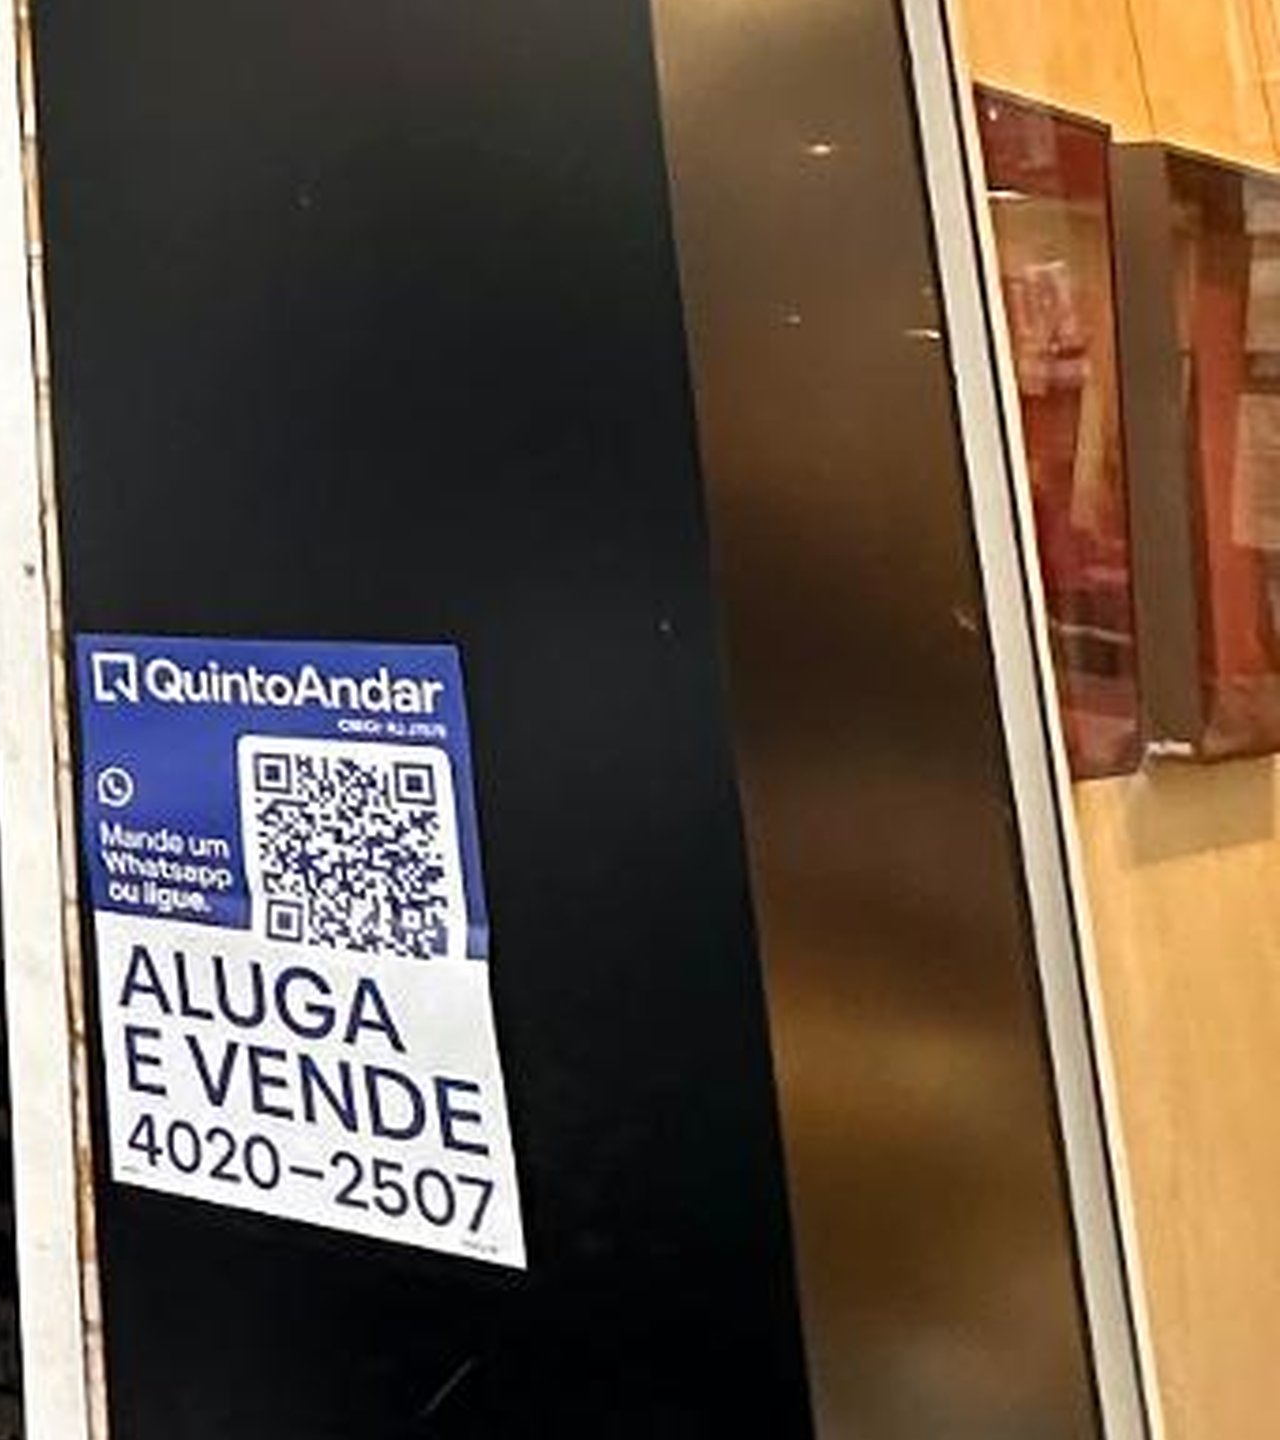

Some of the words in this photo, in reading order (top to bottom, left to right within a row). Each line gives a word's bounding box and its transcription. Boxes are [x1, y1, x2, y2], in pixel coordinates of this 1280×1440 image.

[145, 658, 444, 714] QuintoAndar
[99, 820, 185, 855] Mande
[189, 836, 230, 859] um
[101, 850, 233, 891] Whatsapp
[109, 881, 140, 904] ou
[118, 944, 406, 1054] ALUGA
[124, 1024, 167, 1096] E
[185, 1033, 490, 1156] VENDE
[127, 1113, 495, 1234] 4020-2507
